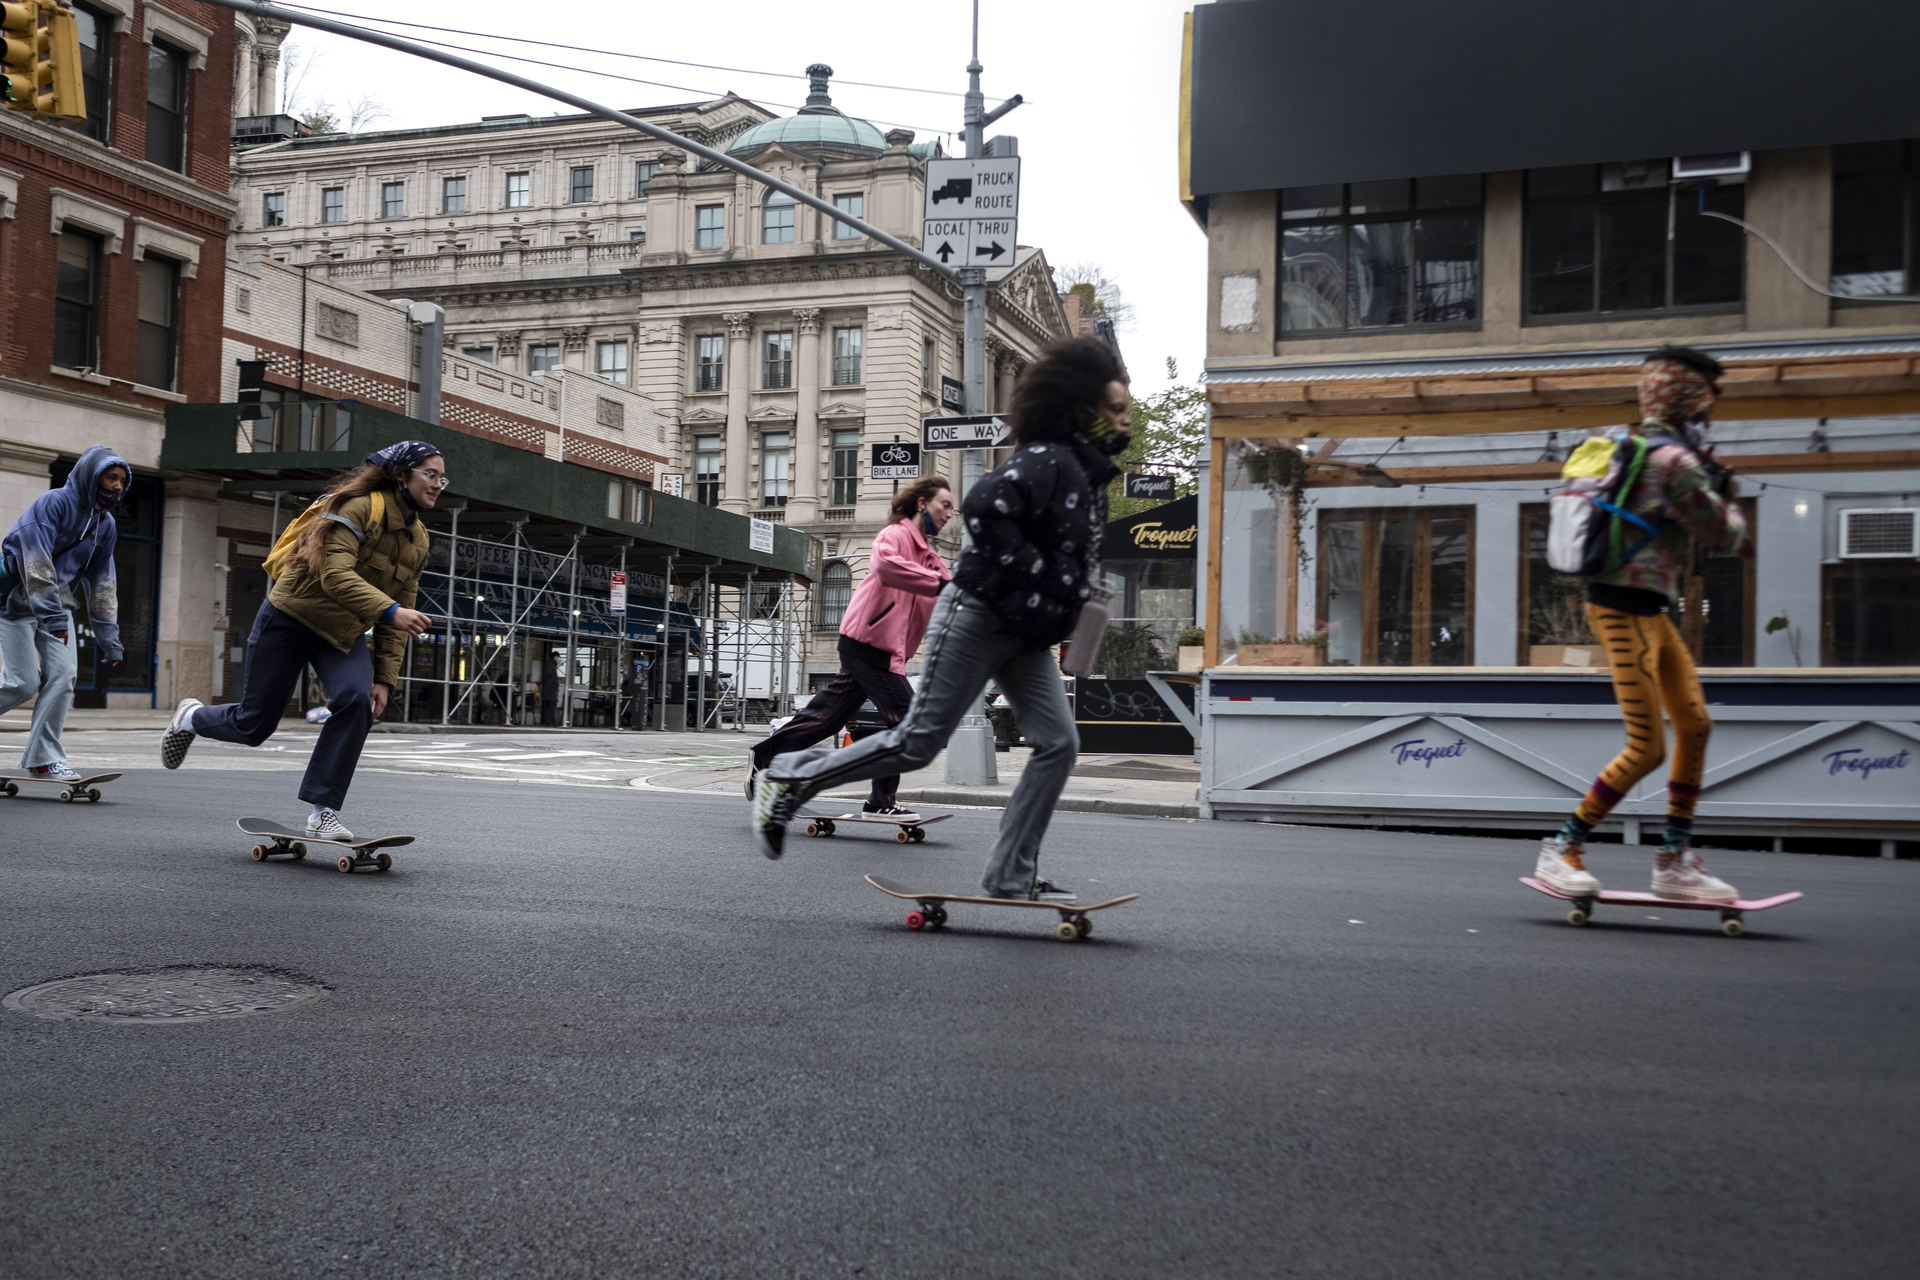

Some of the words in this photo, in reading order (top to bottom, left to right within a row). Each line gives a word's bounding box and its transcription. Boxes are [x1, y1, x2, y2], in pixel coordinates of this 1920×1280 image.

[976, 171, 1015, 186] TRUCK
[974, 195, 1014, 209] ROUTE
[927, 222, 966, 236] LOCAL
[976, 221, 1010, 236] THRU
[943, 386, 959, 403] ONE
[930, 427, 959, 440] ONE
[973, 424, 1004, 438] WAY
[873, 467, 892, 477] BIKE
[895, 466, 918, 476] LANE
[1130, 477, 1171, 496] Troquet
[1129, 521, 1199, 551] Troquet
[1390, 739, 1468, 769] Troquet
[1821, 748, 1911, 780] Troquet
